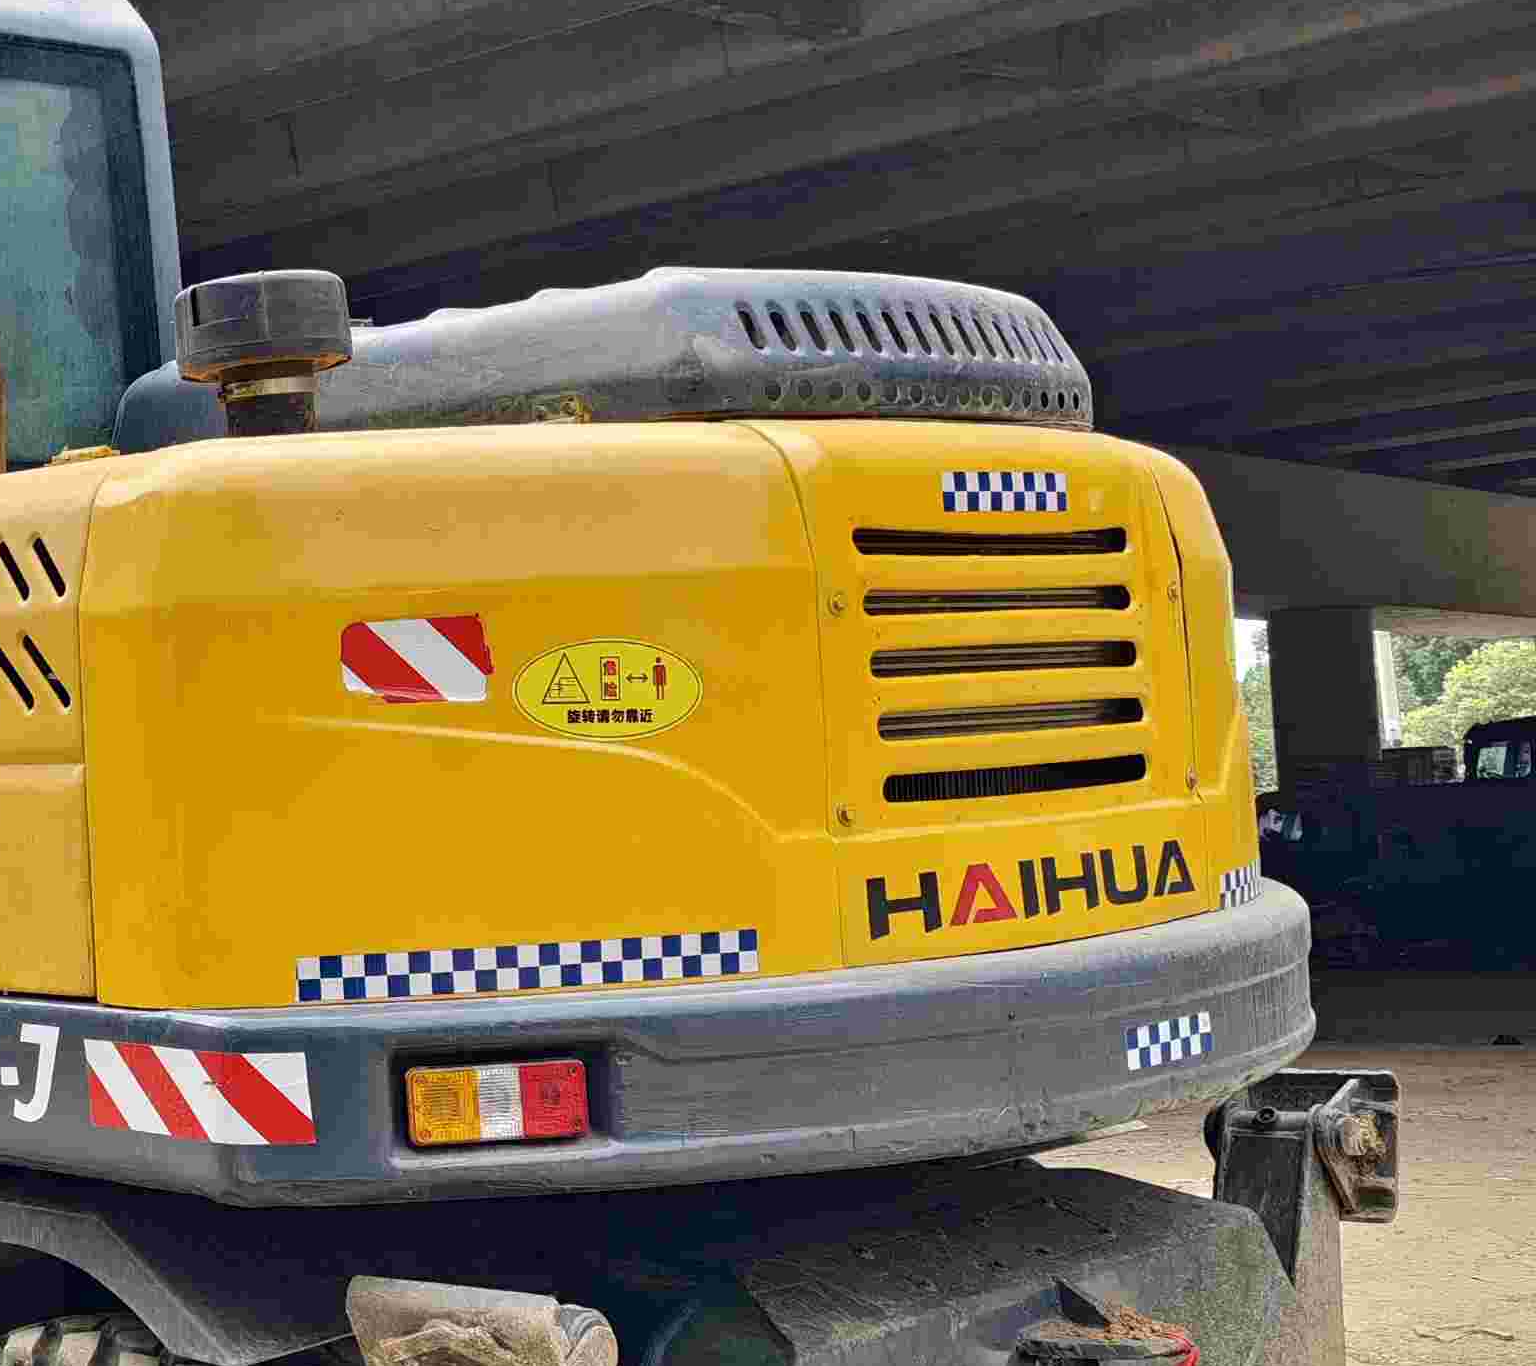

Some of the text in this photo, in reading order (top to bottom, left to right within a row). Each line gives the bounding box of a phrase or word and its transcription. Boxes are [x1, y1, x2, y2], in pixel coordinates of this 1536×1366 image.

[567, 708, 654, 723] 旋转请勿靠近
[866, 838, 1196, 940] HAIHUA
